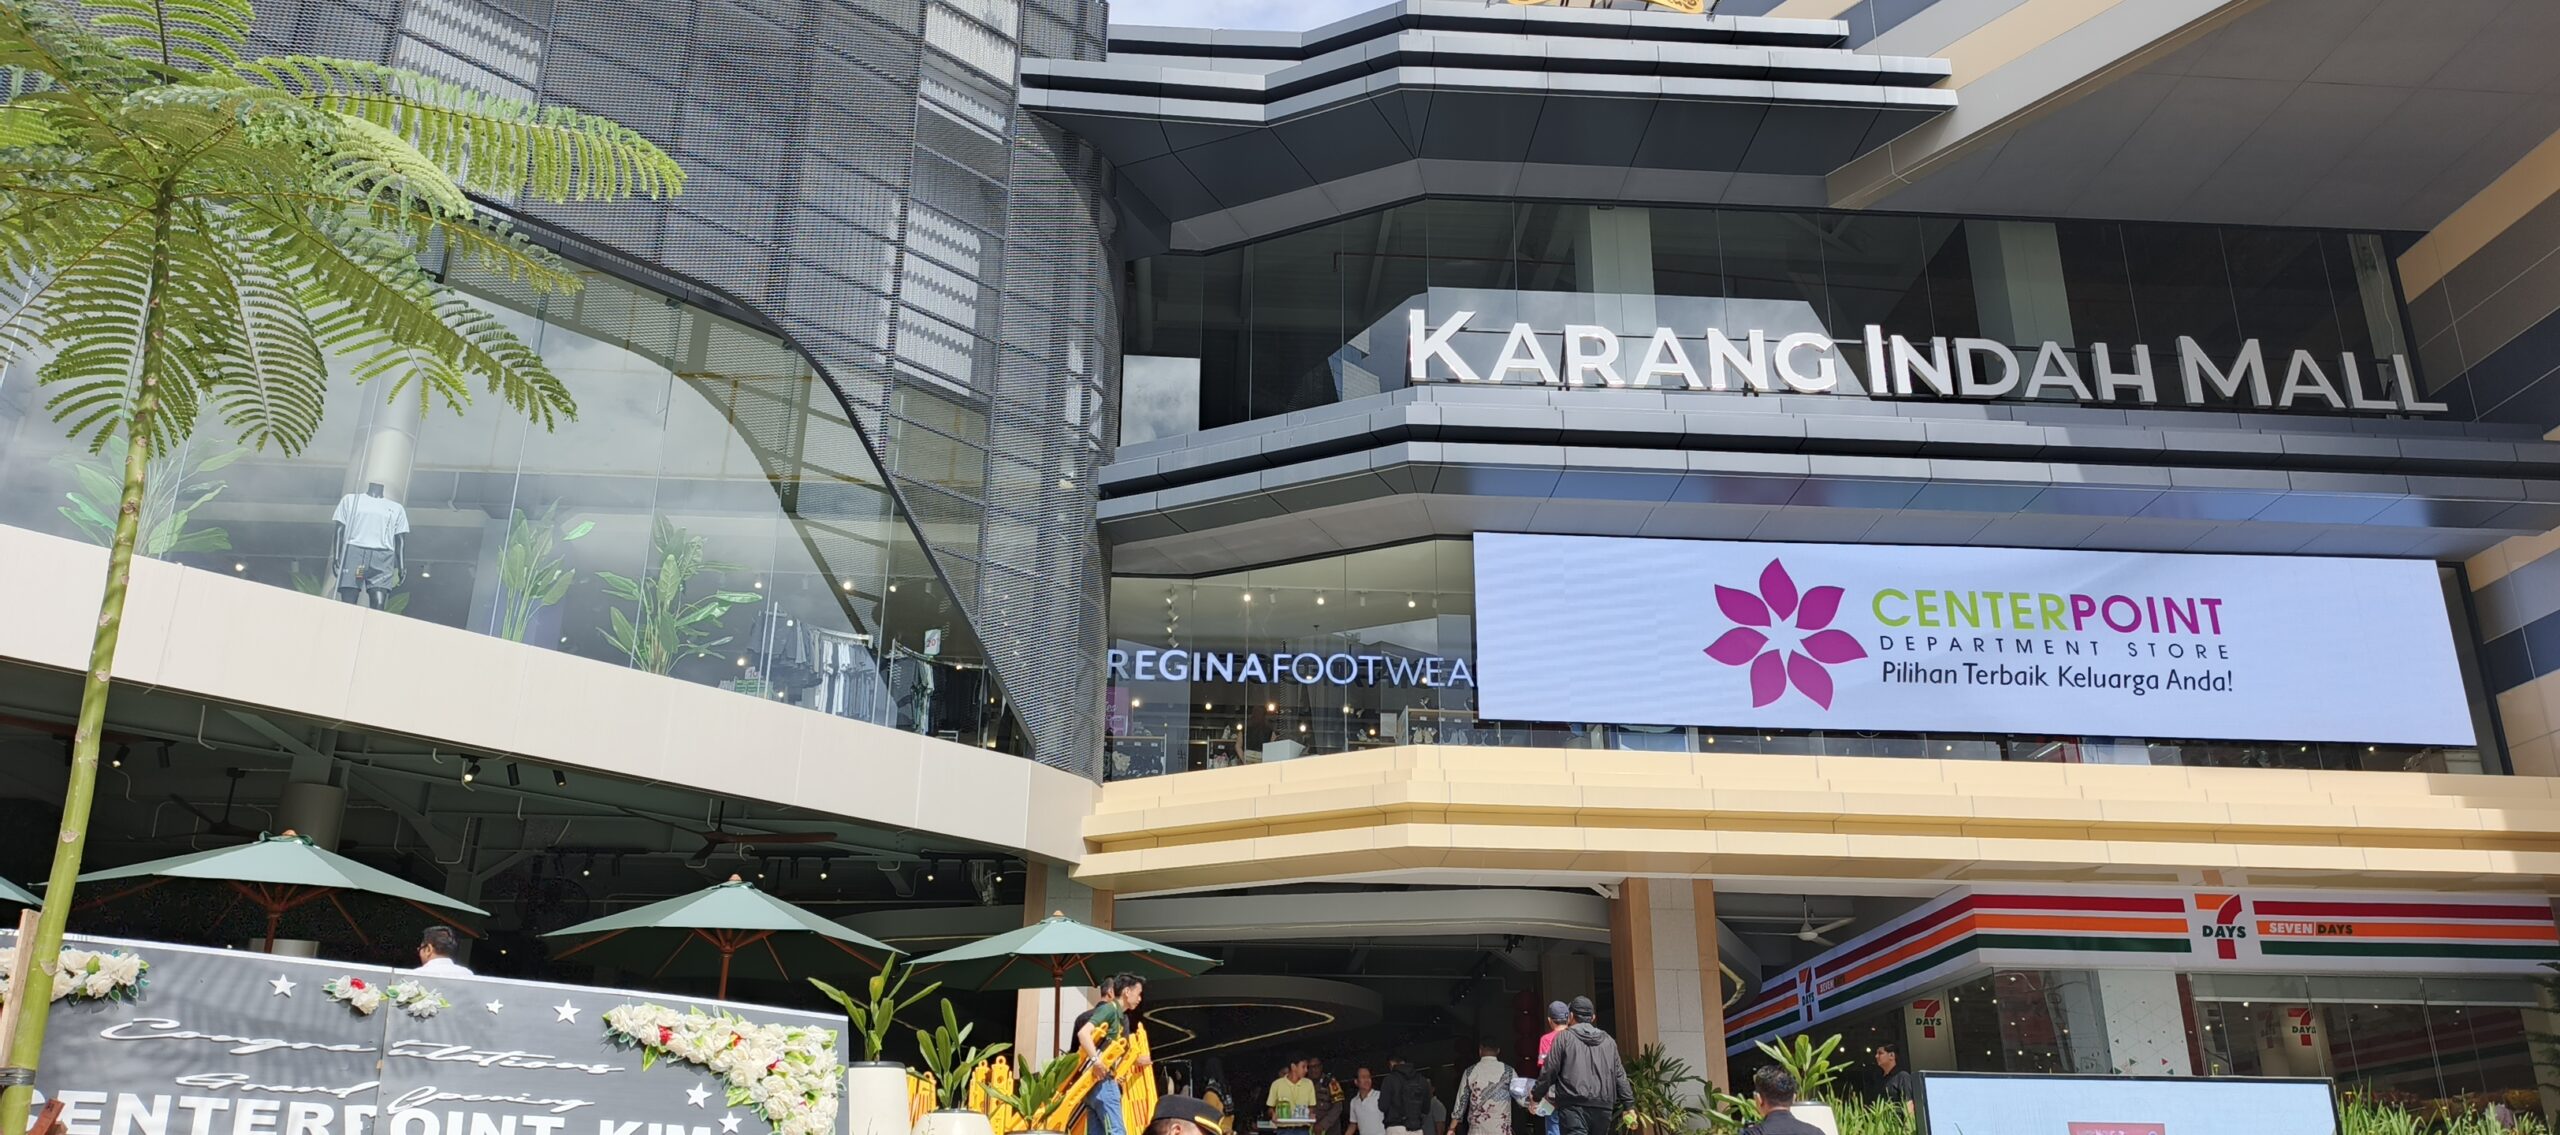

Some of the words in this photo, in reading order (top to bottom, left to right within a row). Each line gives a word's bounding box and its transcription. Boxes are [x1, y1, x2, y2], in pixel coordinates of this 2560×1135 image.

[1410, 309, 1837, 394] KARANG
[1864, 324, 2158, 405] INDAH
[2176, 335, 2448, 411] MALL
[1872, 588, 2222, 635] CENTERPOINT
[1880, 635, 2098, 656] DEPARTMENT
[2127, 642, 2229, 660] STORE
[1107, 649, 1478, 688] REGINAFOOTWEA
[1882, 661, 1957, 684] Pilihan
[1962, 663, 2049, 687] Terbaik
[2058, 665, 2160, 696] Keluarga
[2166, 669, 2232, 692] Anda!
[2194, 893, 2242, 959] 7
[2202, 925, 2246, 939] DAYS
[2269, 922, 2313, 934] SEVEN
[2317, 924, 2353, 934] DAYS
[1913, 1000, 1940, 1038] 7
[1915, 1018, 1942, 1026] DAYS
[26, 1089, 566, 1135] ENTEROI
